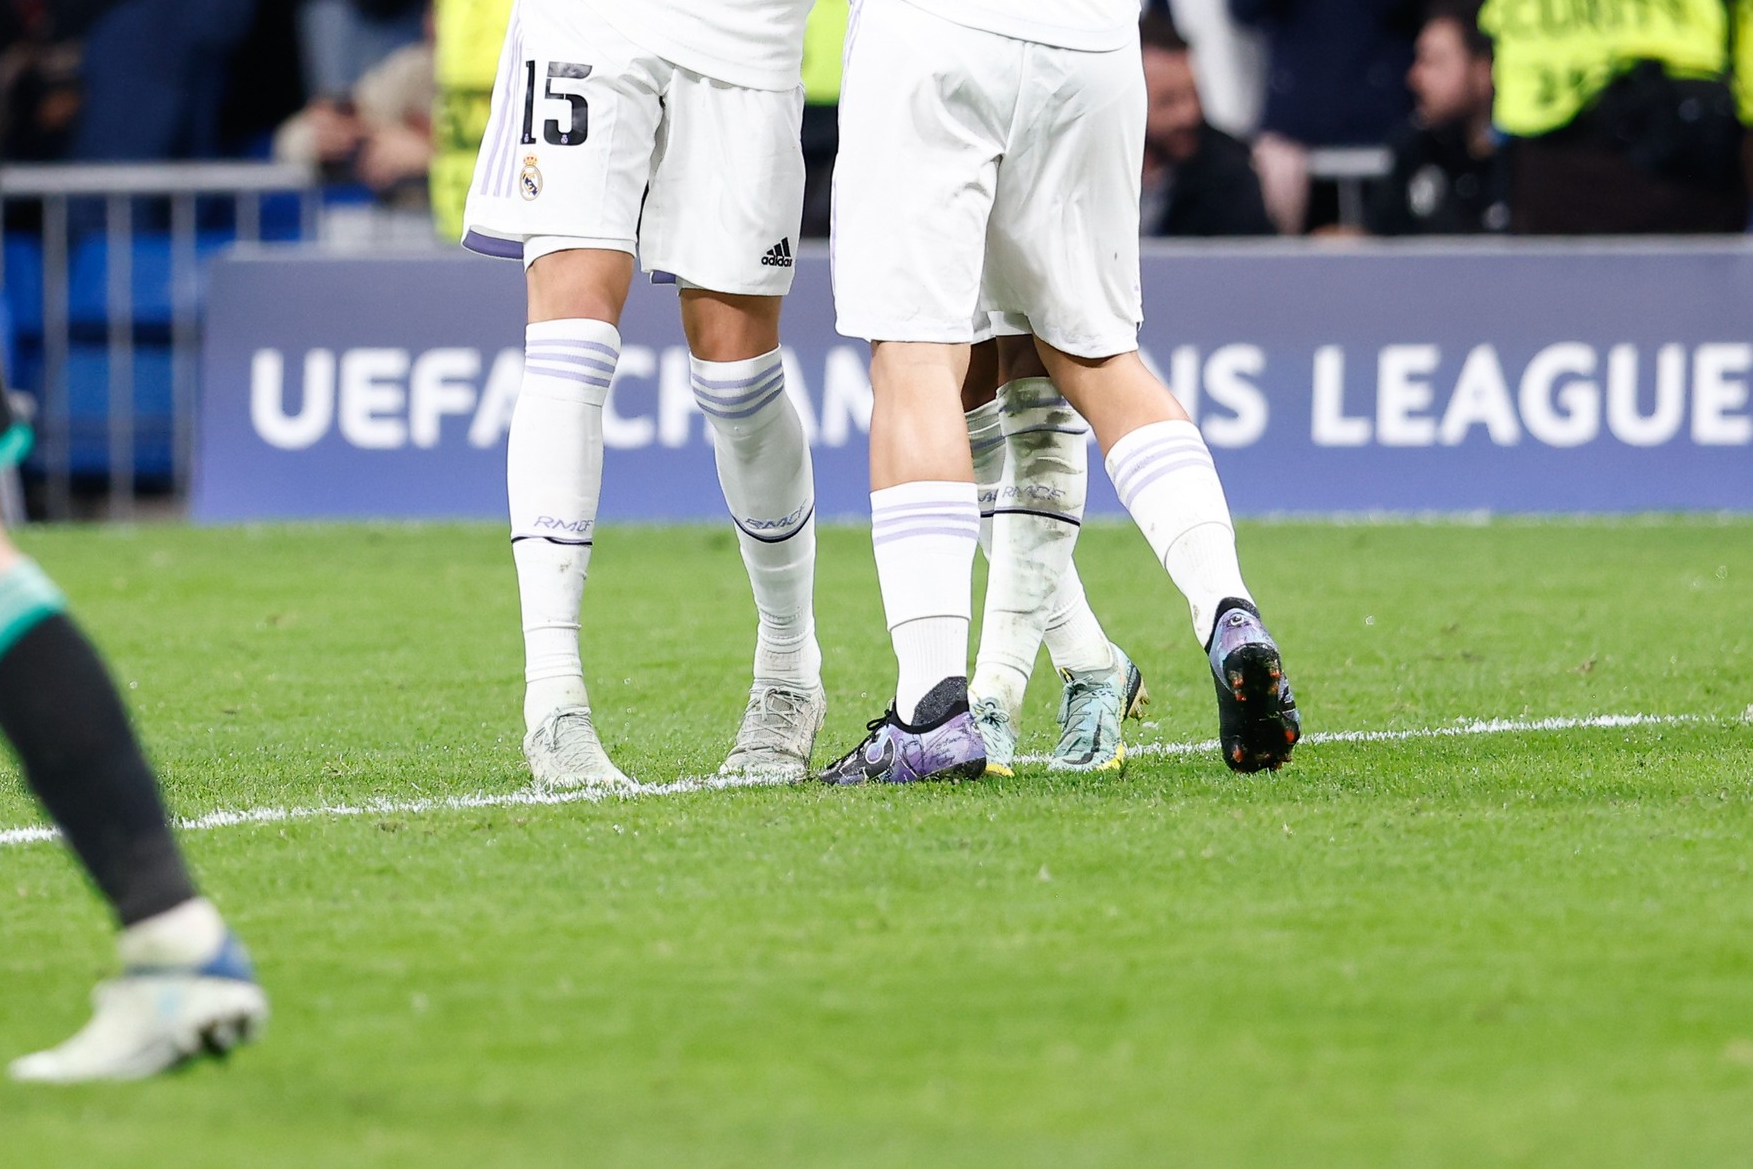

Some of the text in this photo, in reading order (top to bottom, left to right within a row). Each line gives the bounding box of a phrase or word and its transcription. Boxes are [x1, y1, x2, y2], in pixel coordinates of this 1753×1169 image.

[520, 59, 593, 147] 15
[761, 254, 793, 268] adidas
[1310, 341, 1753, 447] LEAGUE
